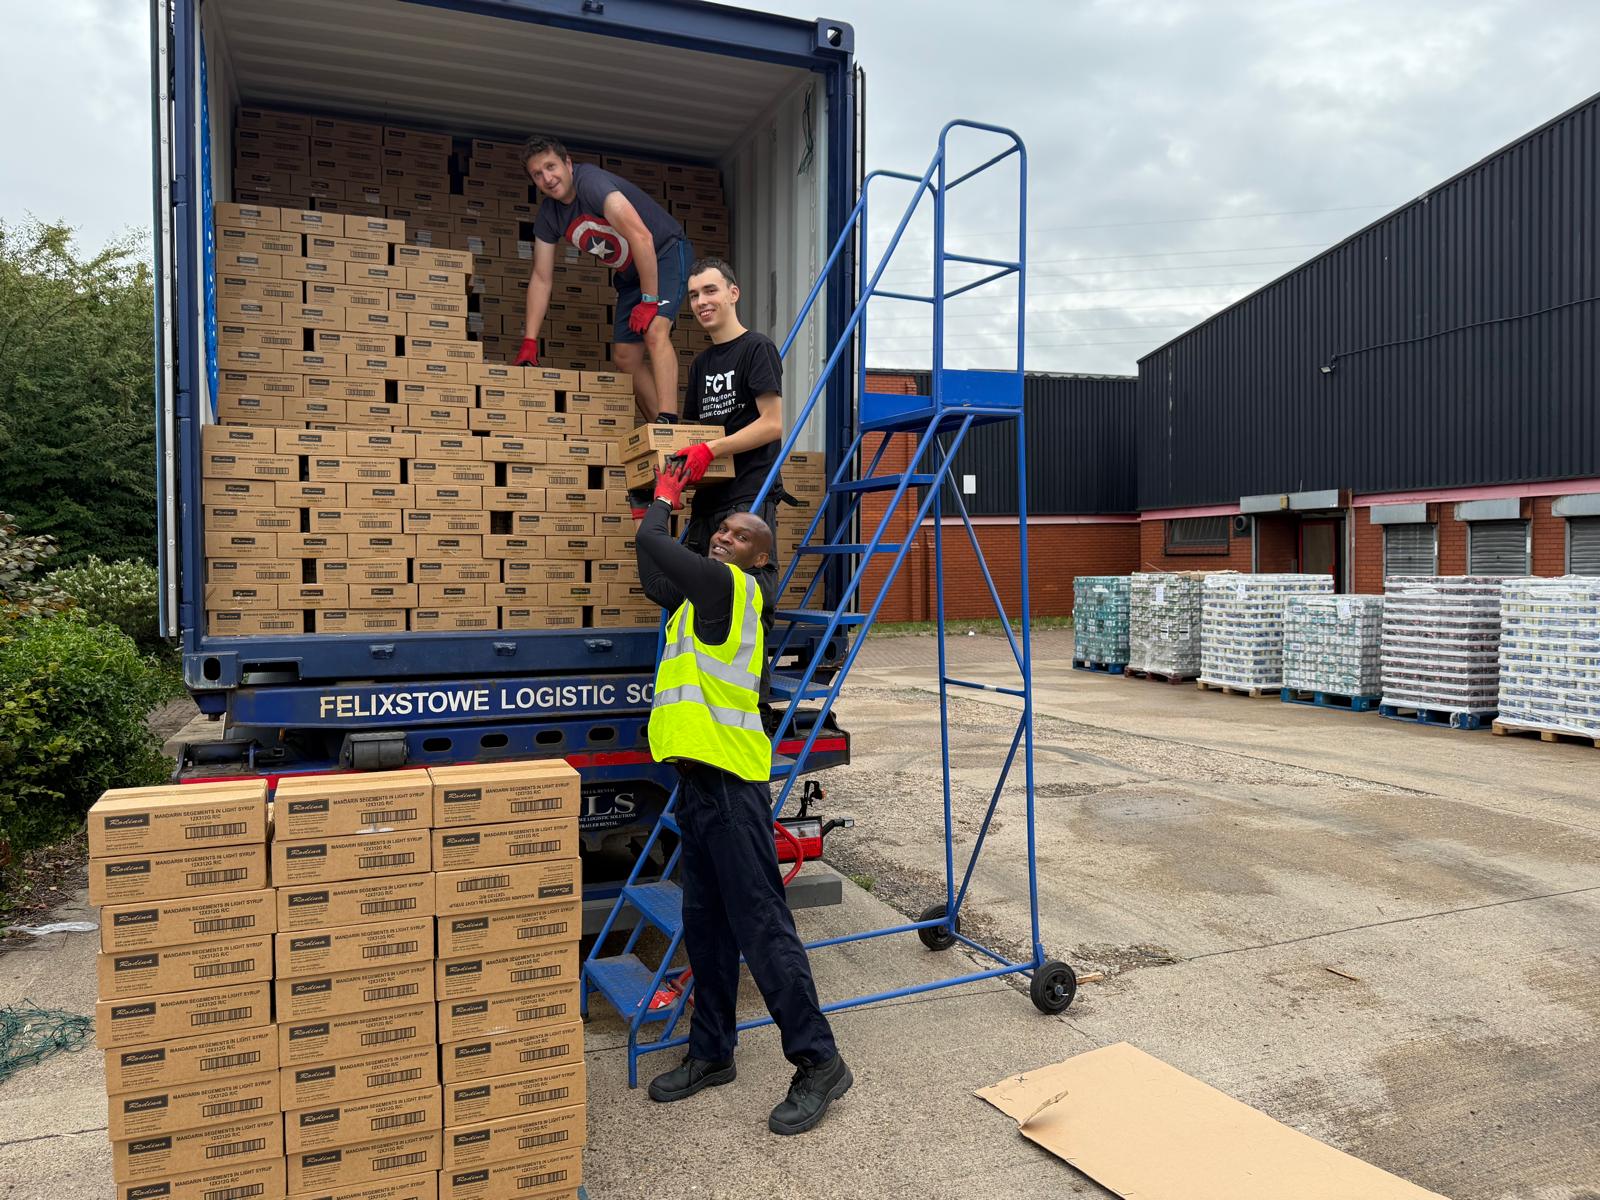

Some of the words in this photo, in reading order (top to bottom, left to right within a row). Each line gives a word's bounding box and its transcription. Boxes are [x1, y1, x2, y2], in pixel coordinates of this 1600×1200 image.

[705, 370, 735, 394] FCT
[320, 689, 489, 718] FELIXSTOWE
[501, 684, 615, 710] LOGISTIC
[183, 809, 215, 817] SEGEMENTS
[184, 855, 216, 863] SEGEMENTS
[163, 907, 191, 915] MANDARIN
[192, 903, 224, 912] SEGEMENTS
[163, 951, 191, 959] MANDARIN
[192, 947, 224, 956] SEGEMENTS
[161, 1000, 189, 1008] MANDARIN
[189, 995, 221, 1004] SEGEMENTS
[170, 1045, 198, 1053] MANDARIN
[198, 1040, 230, 1049] SEGEMENTS
[173, 1091, 201, 1100] MANDARIN
[201, 1086, 233, 1096] SEGEMENTS
[176, 1133, 204, 1141] MANDARIN
[204, 1127, 235, 1137] SEGEMENTS
